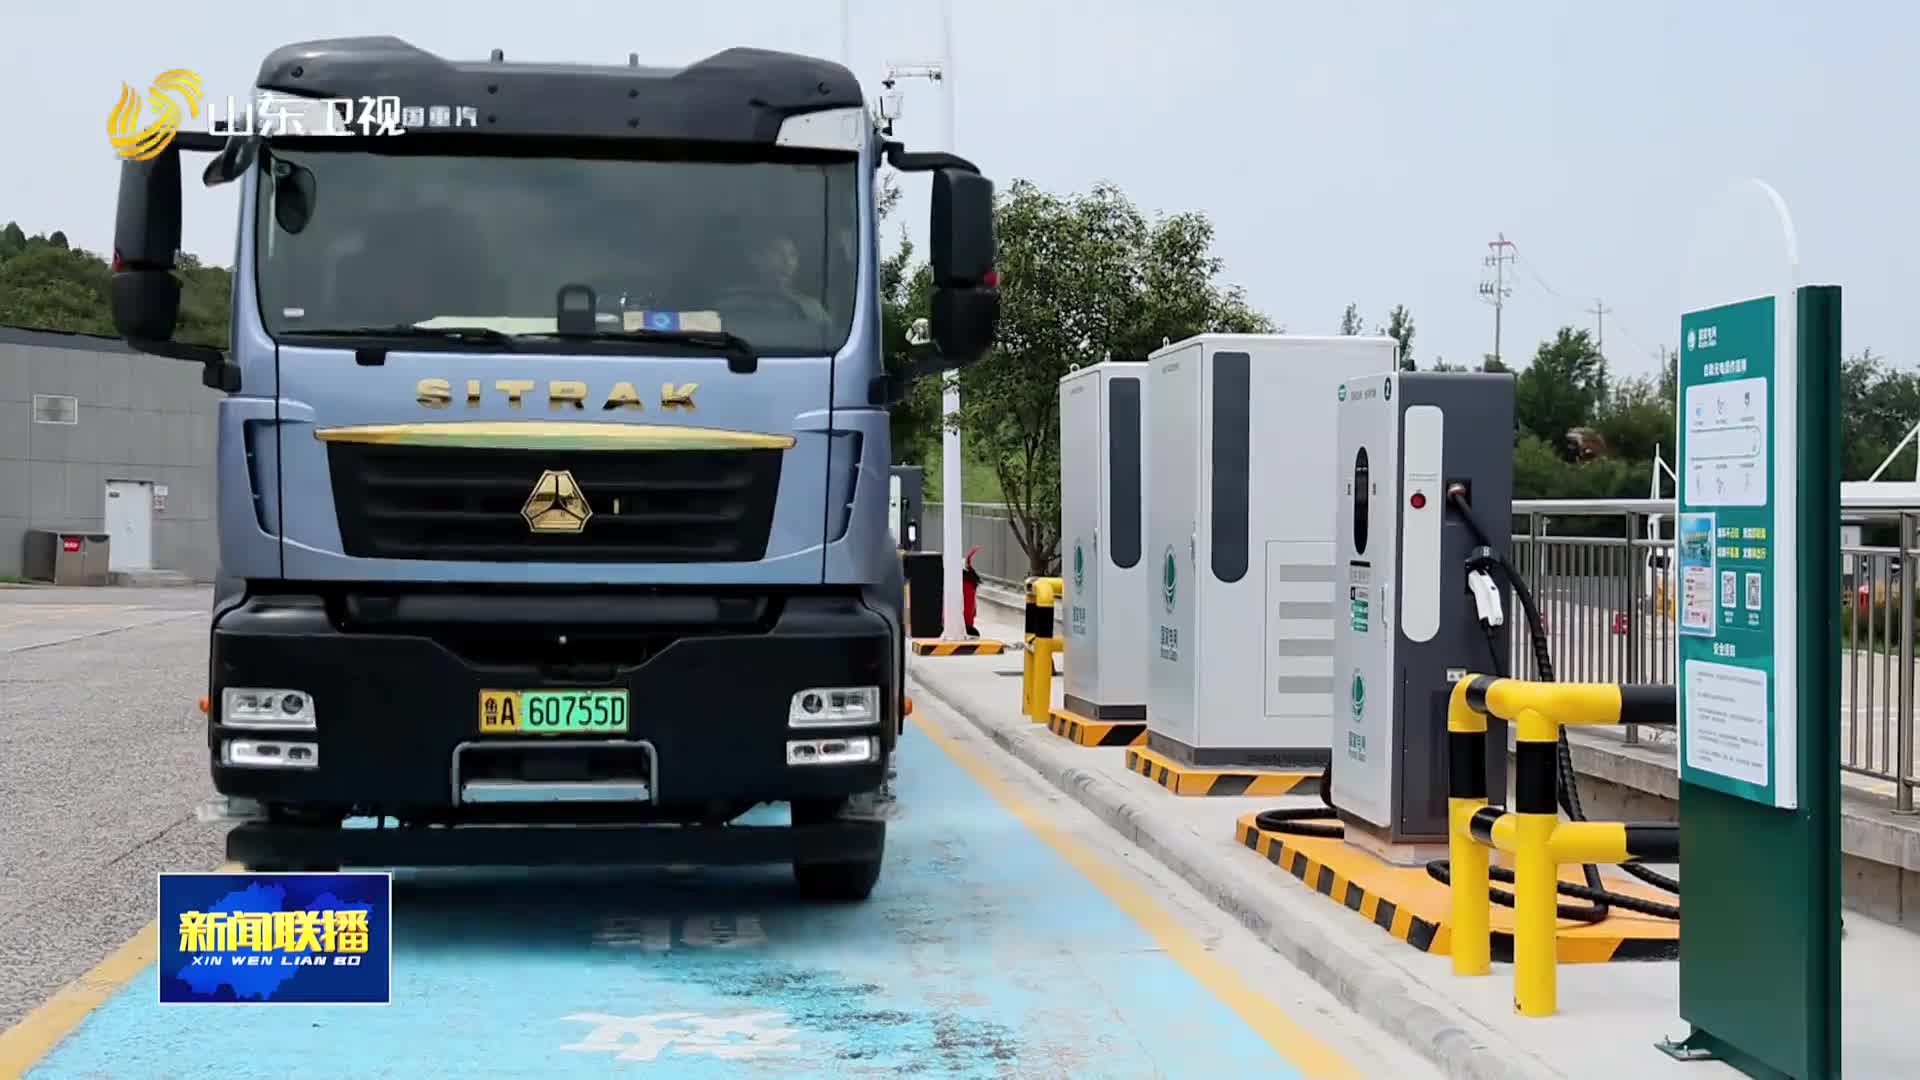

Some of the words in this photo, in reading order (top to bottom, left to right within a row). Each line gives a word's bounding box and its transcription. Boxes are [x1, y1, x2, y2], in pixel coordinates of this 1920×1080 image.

[379, 106, 478, 127] 国重汽
[416, 378, 698, 410] SITRAK
